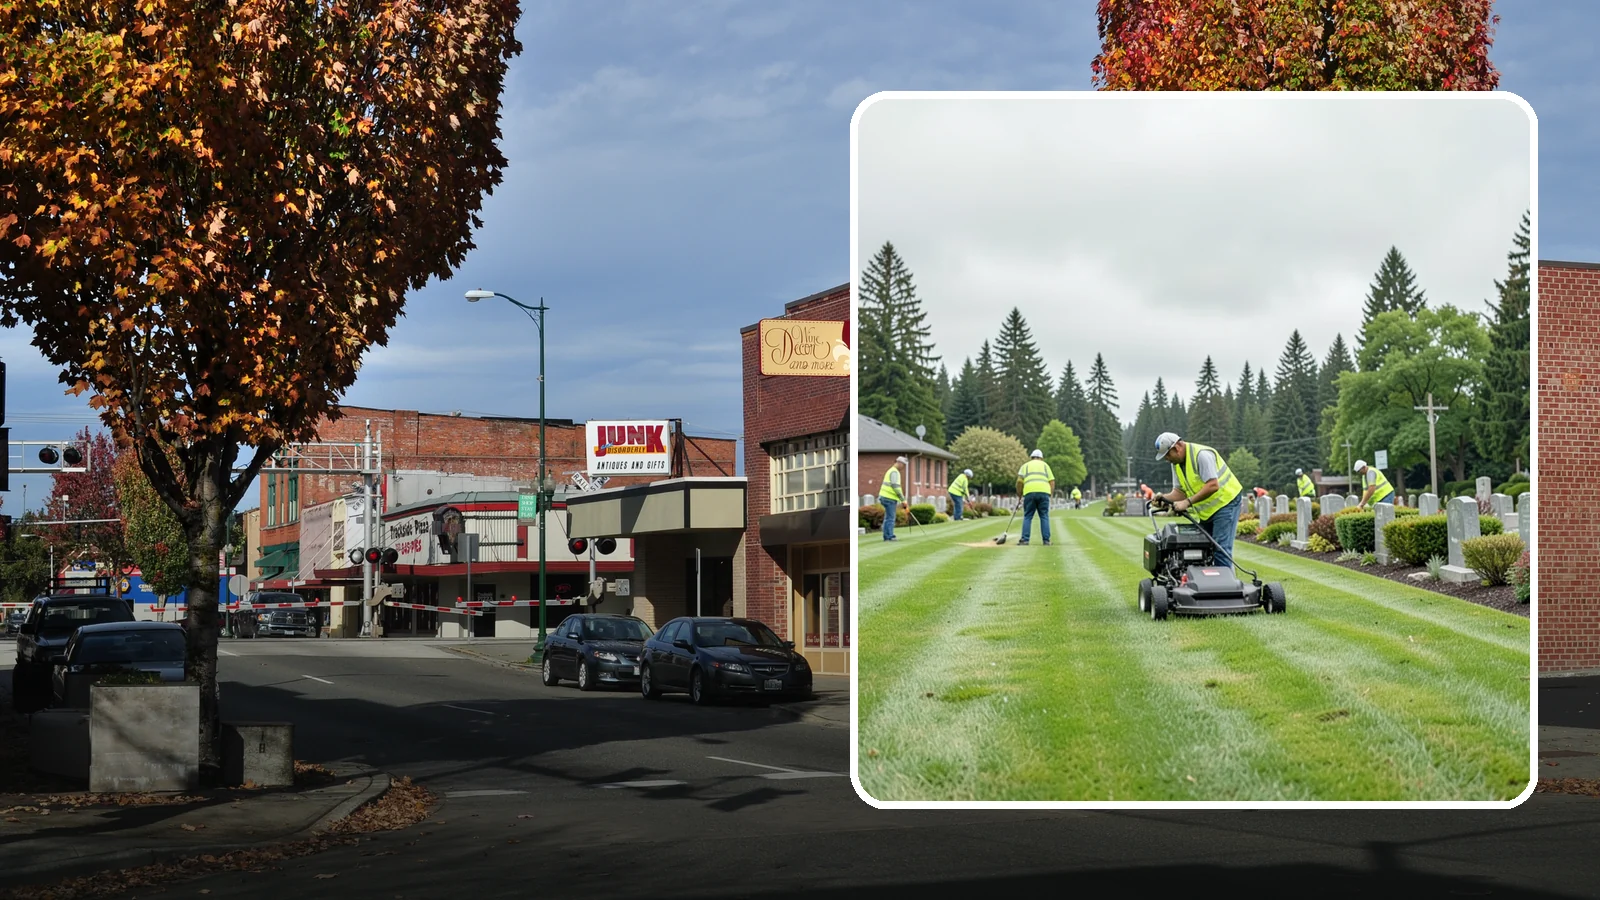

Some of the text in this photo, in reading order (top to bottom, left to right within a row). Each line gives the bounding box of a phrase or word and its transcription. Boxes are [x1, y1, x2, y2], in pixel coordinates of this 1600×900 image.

[595, 425, 665, 457] JUNK
[607, 446, 646, 454] DISORDERLY
[596, 460, 665, 470] ANTIQUES AND GIFTS
[390, 519, 429, 540] Trackside Pizza
